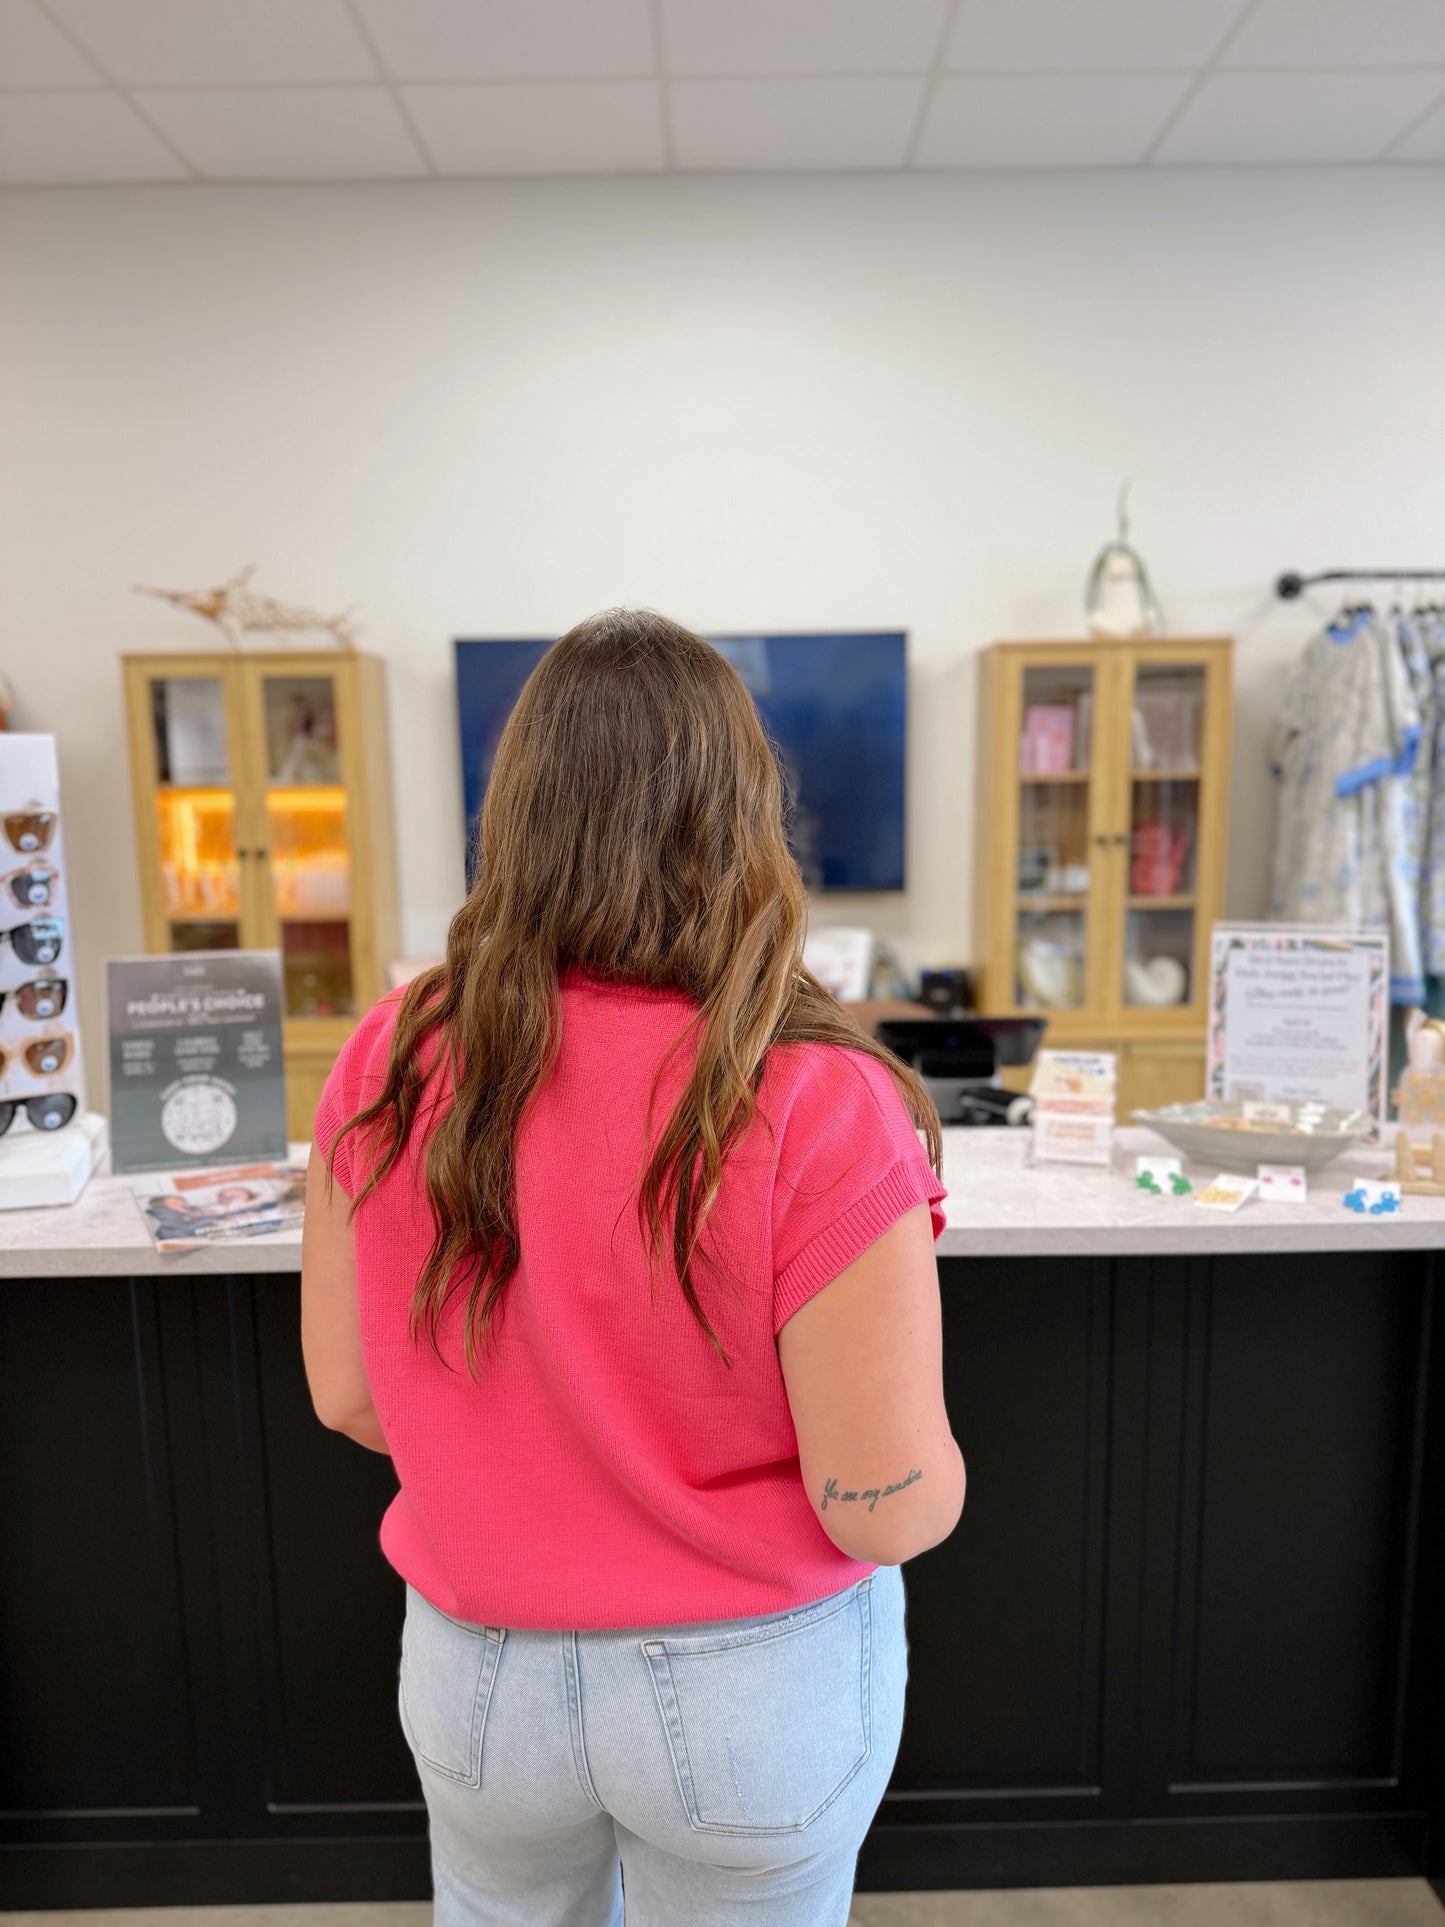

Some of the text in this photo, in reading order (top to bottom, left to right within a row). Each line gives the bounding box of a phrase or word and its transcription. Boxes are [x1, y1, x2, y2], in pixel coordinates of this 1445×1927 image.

[126, 992, 265, 1015] PEOPLE'S CHOICE
[861, 1488, 881, 1513] my
